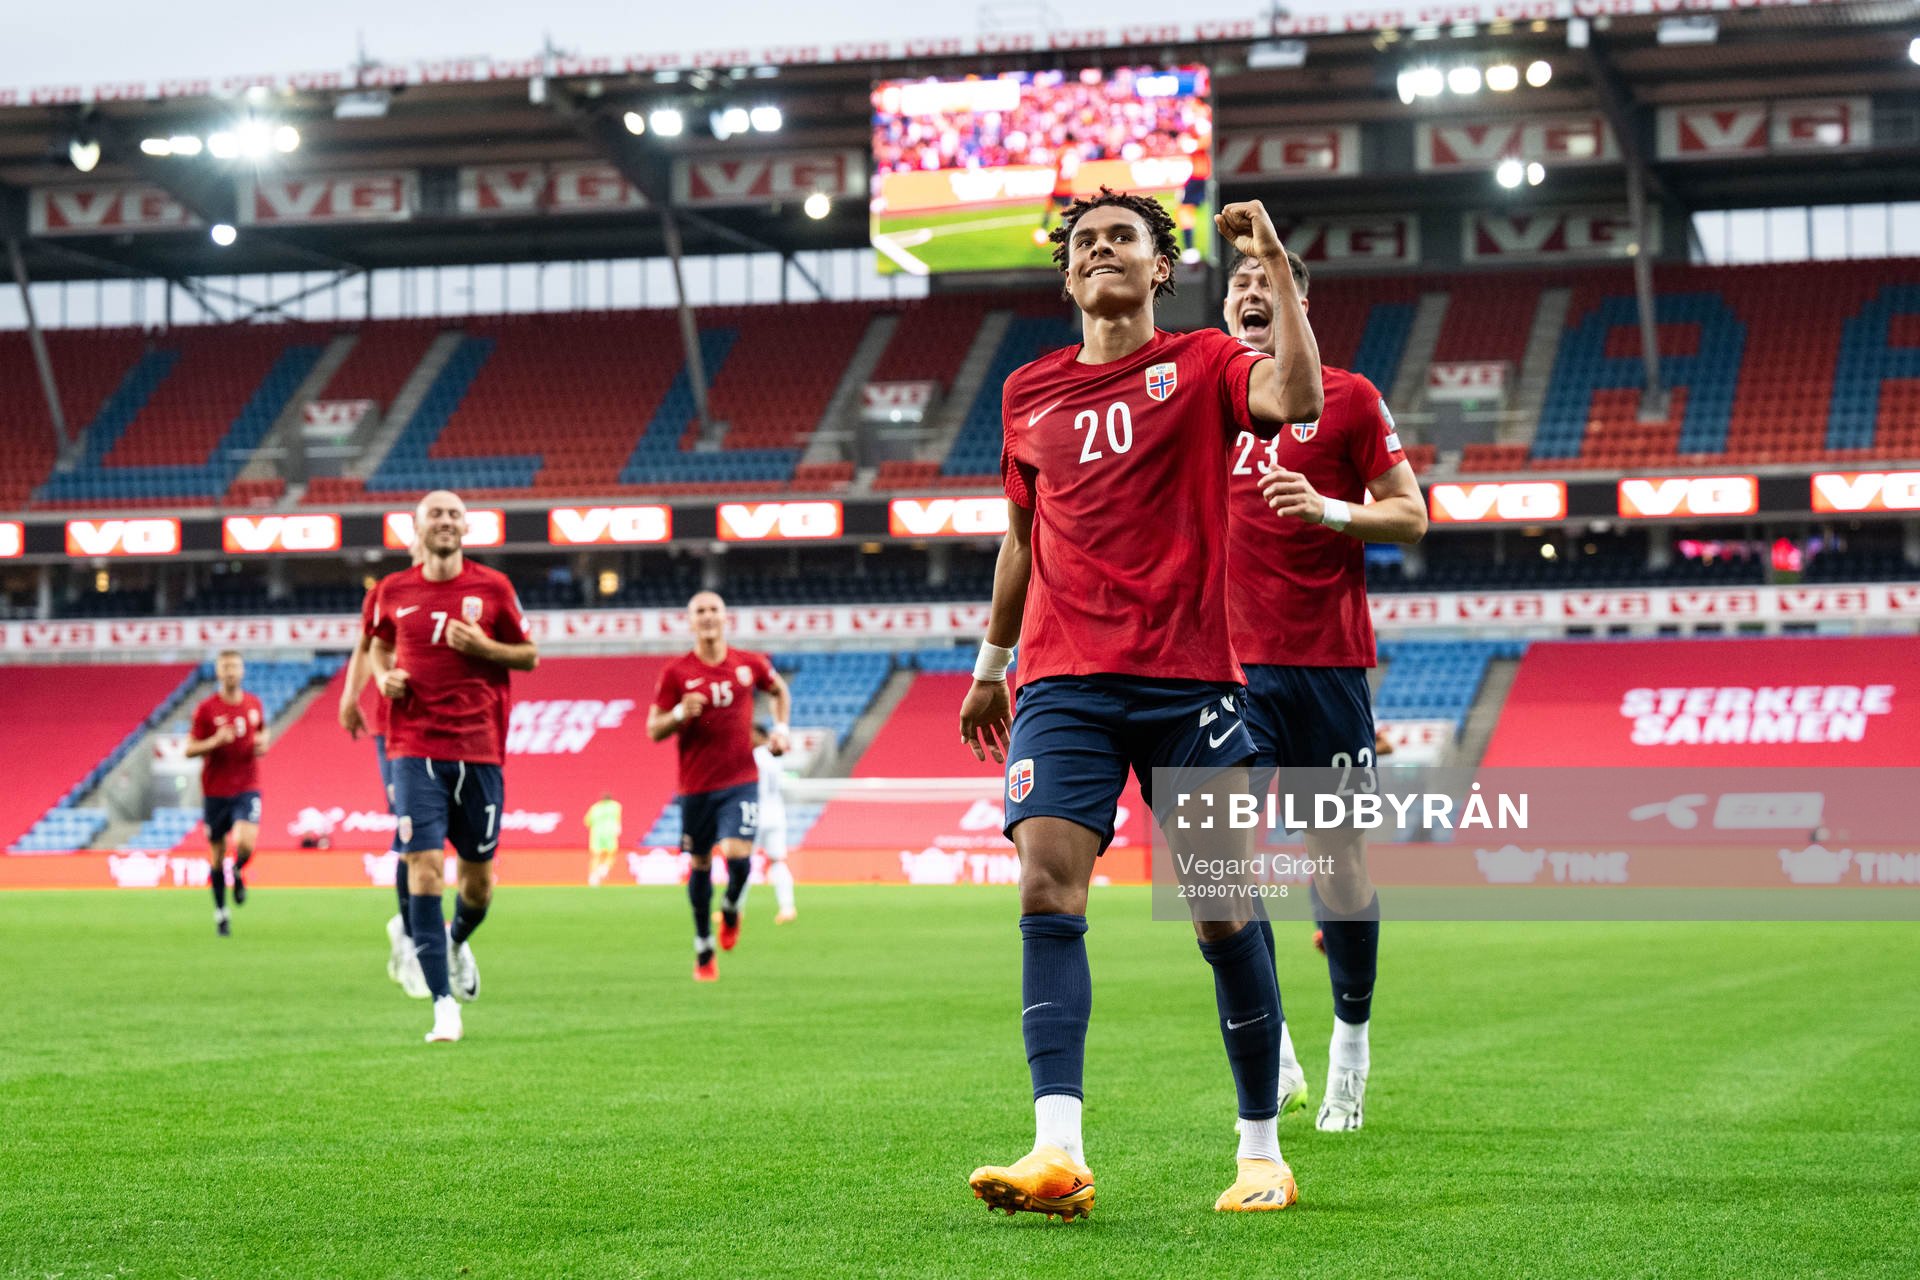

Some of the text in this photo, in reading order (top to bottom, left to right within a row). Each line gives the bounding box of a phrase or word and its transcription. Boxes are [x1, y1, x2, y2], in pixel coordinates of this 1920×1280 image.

[1677, 104, 1848, 152] VG
[689, 155, 846, 198] VG
[254, 178, 403, 224] VG
[1074, 401, 1133, 464] 20
[1232, 430, 1283, 476] 23
[1433, 483, 1564, 521] VG
[1621, 478, 1754, 516] VG
[68, 520, 180, 555] VG
[226, 516, 338, 551] VG
[550, 508, 669, 543] VG
[719, 503, 840, 539] VG
[893, 500, 1009, 536] VG
[430, 611, 448, 644] 7
[708, 680, 734, 708] 15
[1620, 684, 1895, 717] STERKERE
[1630, 710, 1868, 745] SAMMEN
[1331, 746, 1378, 797] 23
[1854, 851, 1920, 884] TIN
